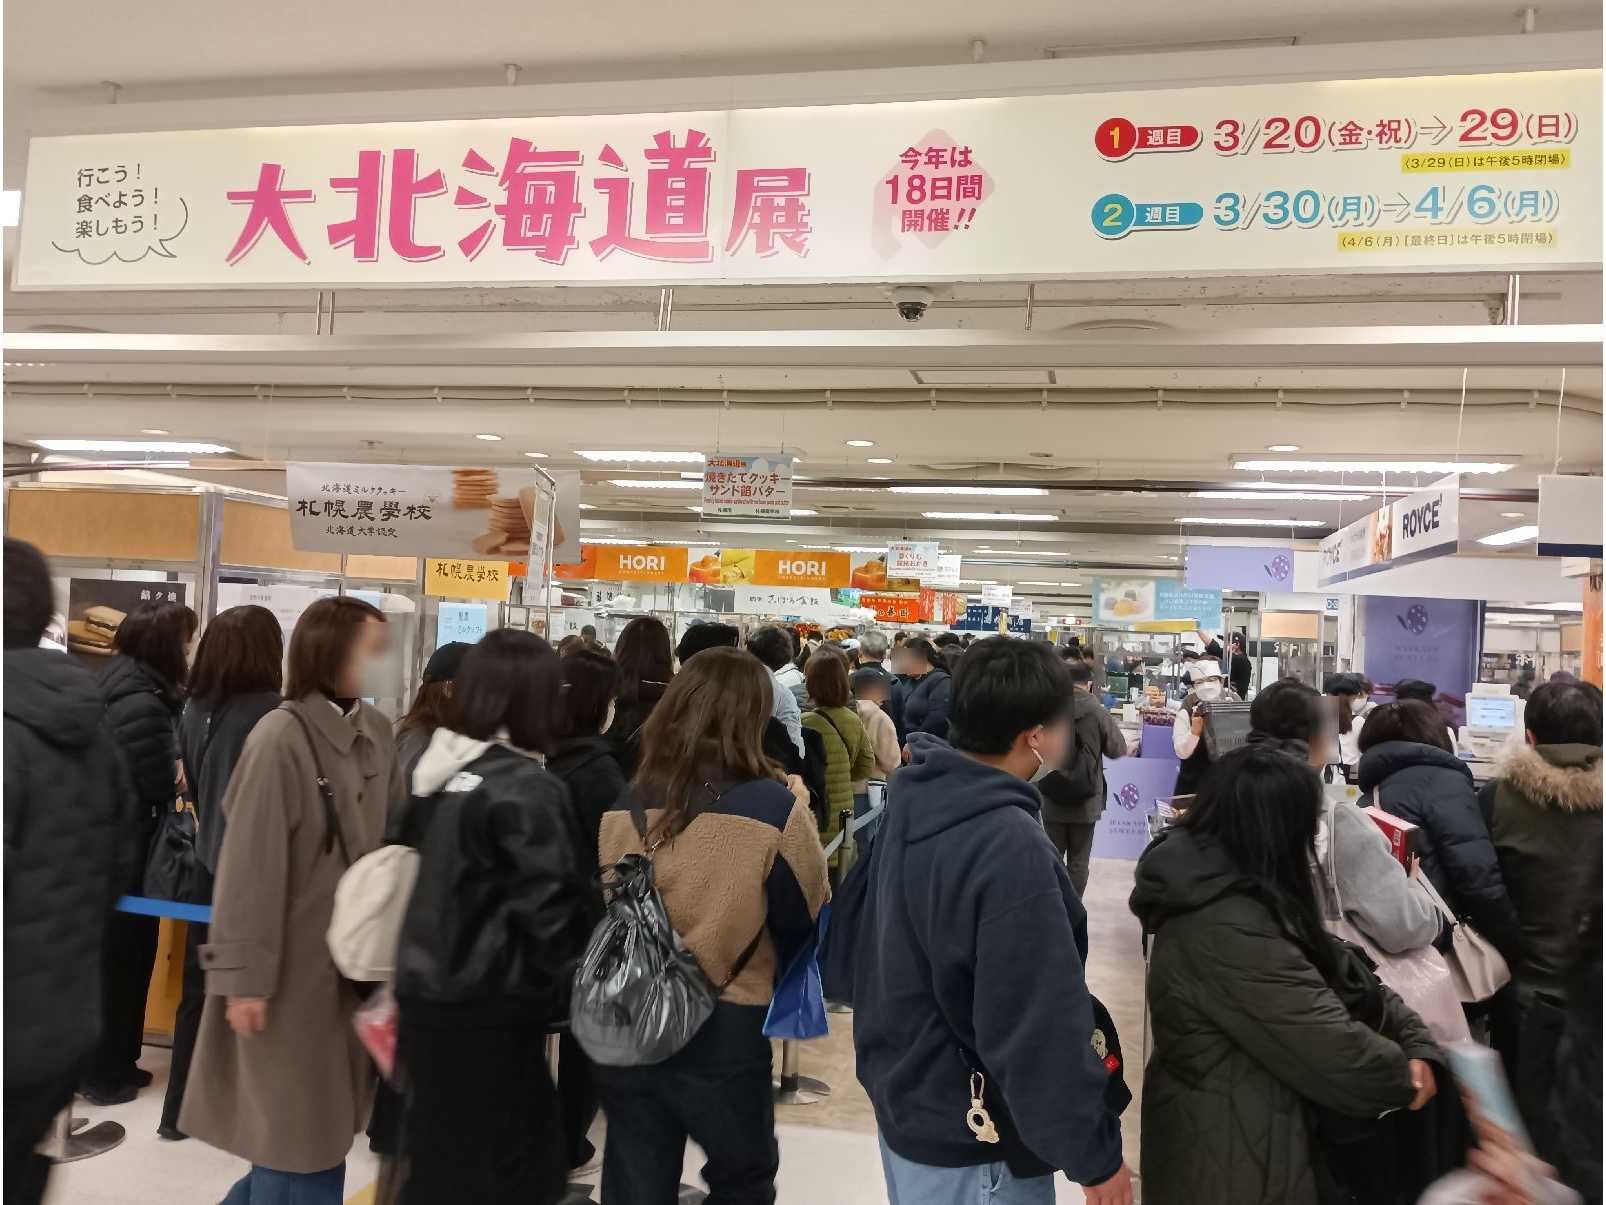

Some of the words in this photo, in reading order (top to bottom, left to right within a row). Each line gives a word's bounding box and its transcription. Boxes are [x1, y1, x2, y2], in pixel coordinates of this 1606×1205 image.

[900, 146, 973, 170] 今年は
[77, 163, 142, 188] 行こう！
[77, 187, 159, 213] 食べよう！
[225, 128, 812, 268] 大北海道展
[885, 174, 983, 204] 18日間
[76, 213, 159, 238] 楽しもう！
[296, 498, 433, 521] 札幌農學校
[619, 554, 665, 571] HORI
[778, 559, 826, 576] HORI
